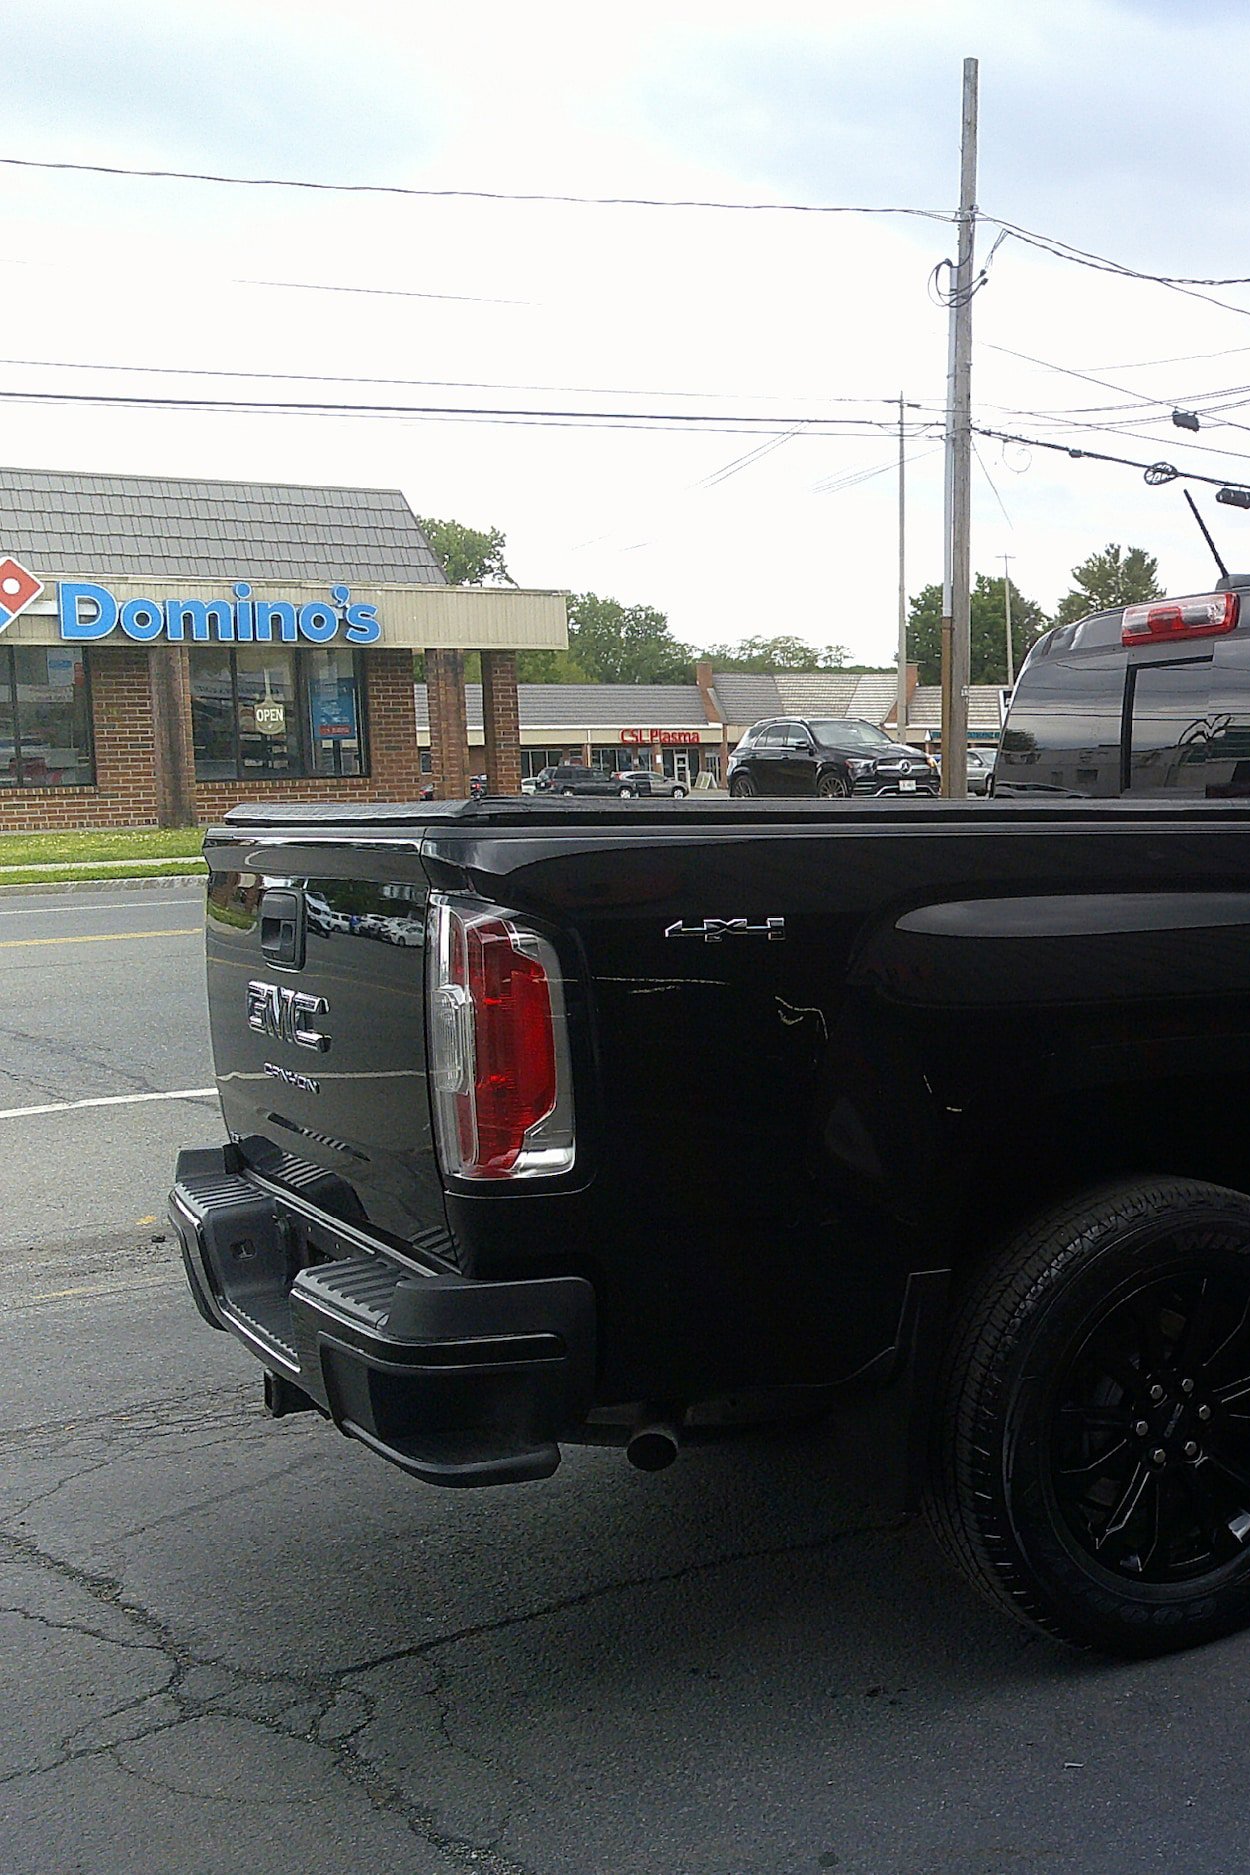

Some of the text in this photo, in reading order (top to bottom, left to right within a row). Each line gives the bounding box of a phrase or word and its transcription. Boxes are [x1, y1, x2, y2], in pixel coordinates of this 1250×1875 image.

[56, 581, 381, 644] Domino's
[256, 708, 284, 722] OPEN
[620, 728, 701, 744] CSL Plasma
